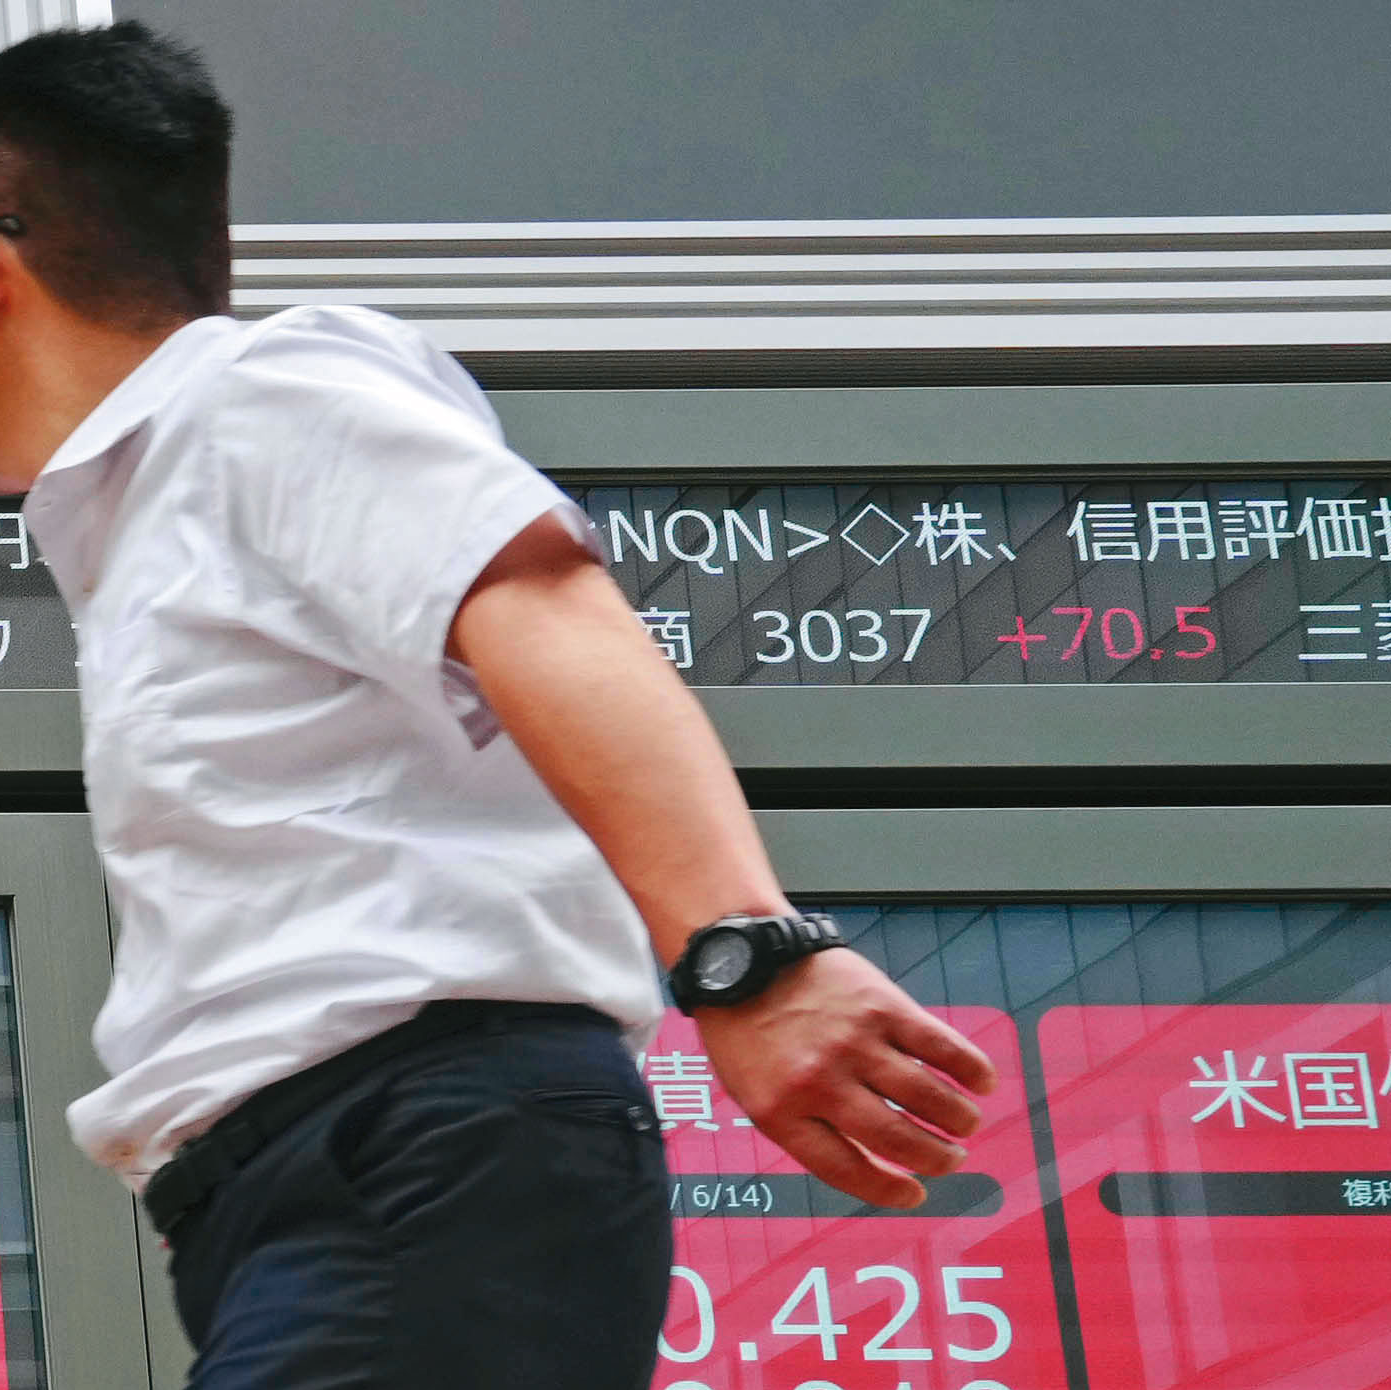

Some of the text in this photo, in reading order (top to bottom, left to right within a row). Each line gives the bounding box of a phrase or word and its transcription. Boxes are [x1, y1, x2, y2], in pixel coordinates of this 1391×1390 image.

[586, 508, 830, 576] NQN>
[752, 608, 932, 663] 3037
[997, 606, 1216, 660] +70.5
[636, 1051, 755, 1132] 債
[1188, 1049, 1391, 1130] 米国
[657, 1264, 1013, 1364] 0.425
